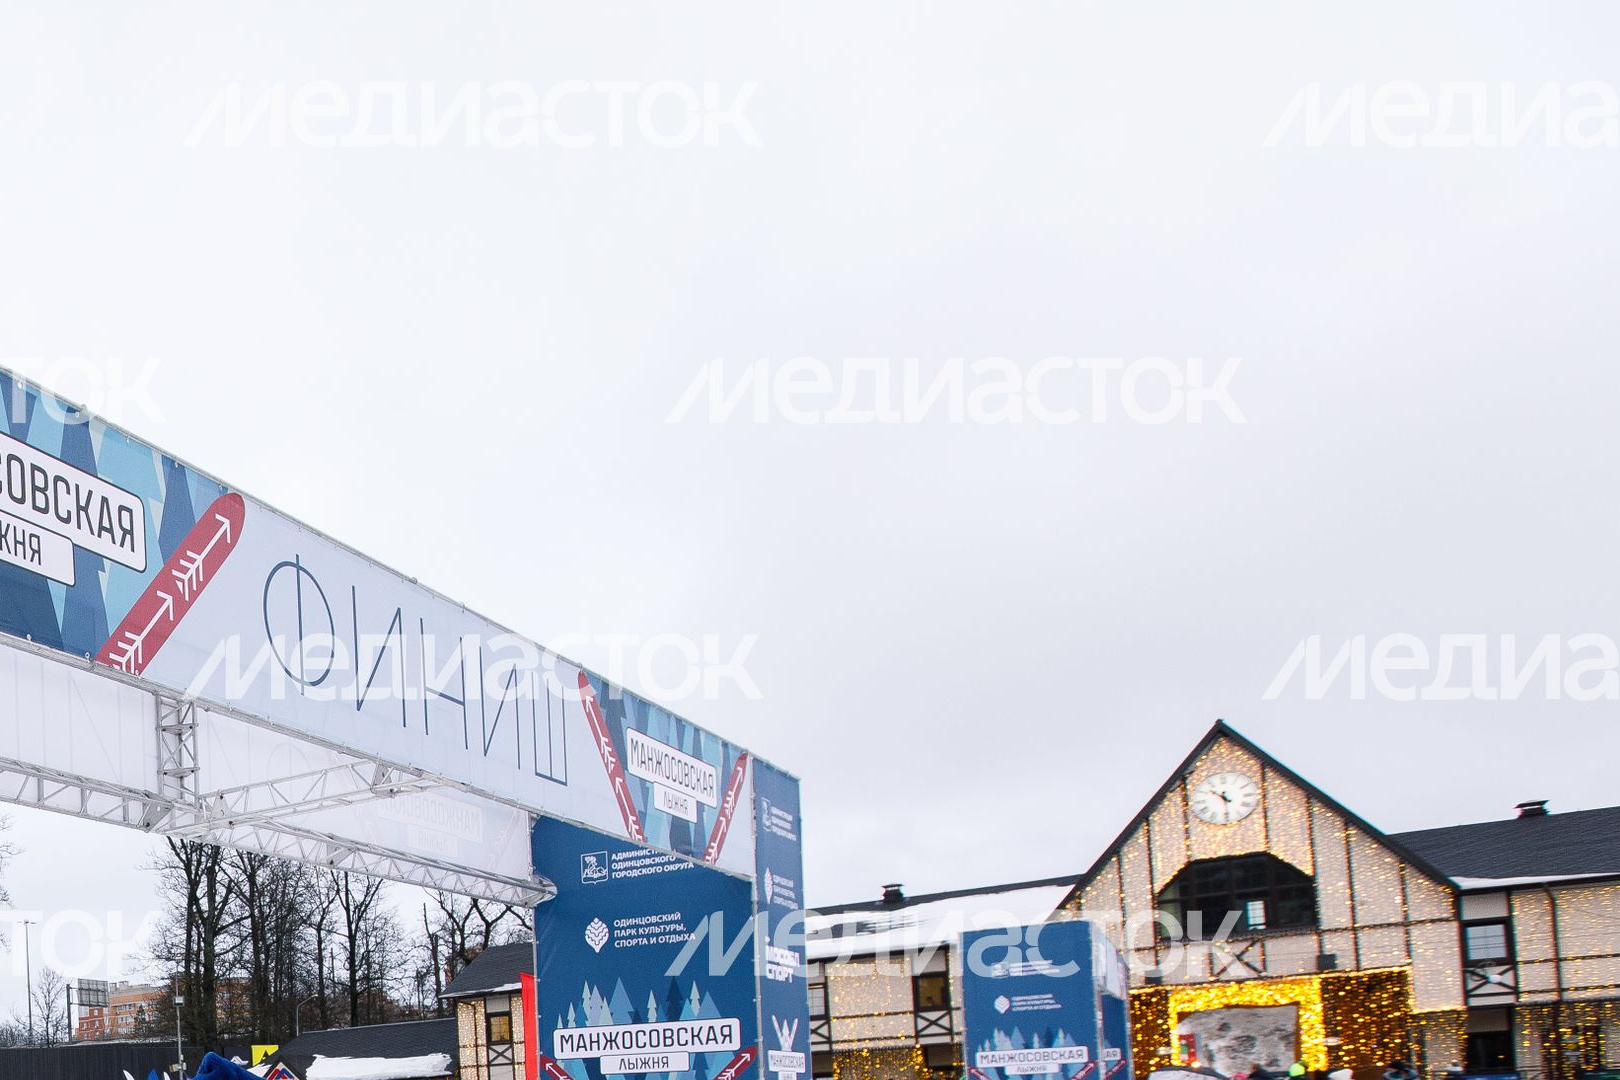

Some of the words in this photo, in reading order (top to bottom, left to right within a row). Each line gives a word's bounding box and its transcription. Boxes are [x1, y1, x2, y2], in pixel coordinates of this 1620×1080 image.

[263, 553, 568, 787] ФИНИШ
[630, 737, 716, 799] МАНЖОСОВСКАЯ
[663, 794, 689, 817] ЛЫЖНЯ
[611, 848, 659, 861] АДМИНИСТ
[611, 856, 677, 870] ОДИНЦОВСКОГО
[612, 866, 664, 879] ГОРОДСКОГО
[664, 862, 695, 872] ОКРУГА
[614, 911, 682, 928] ОДИНЦОВСКИЙ
[614, 928, 638, 938] ПАРК
[638, 923, 687, 936] КУЛЬТУРЫ,
[614, 936, 648, 948] СПОРТА
[650, 936, 657, 944] И
[658, 932, 696, 944] ОТДЫХА
[559, 1023, 733, 1054] МАНЖОСОВСКАЯ
[618, 1055, 670, 1072] ЛЫЖНЯ
[980, 1049, 1084, 1064] МАНЖОСОВСКАЯ
